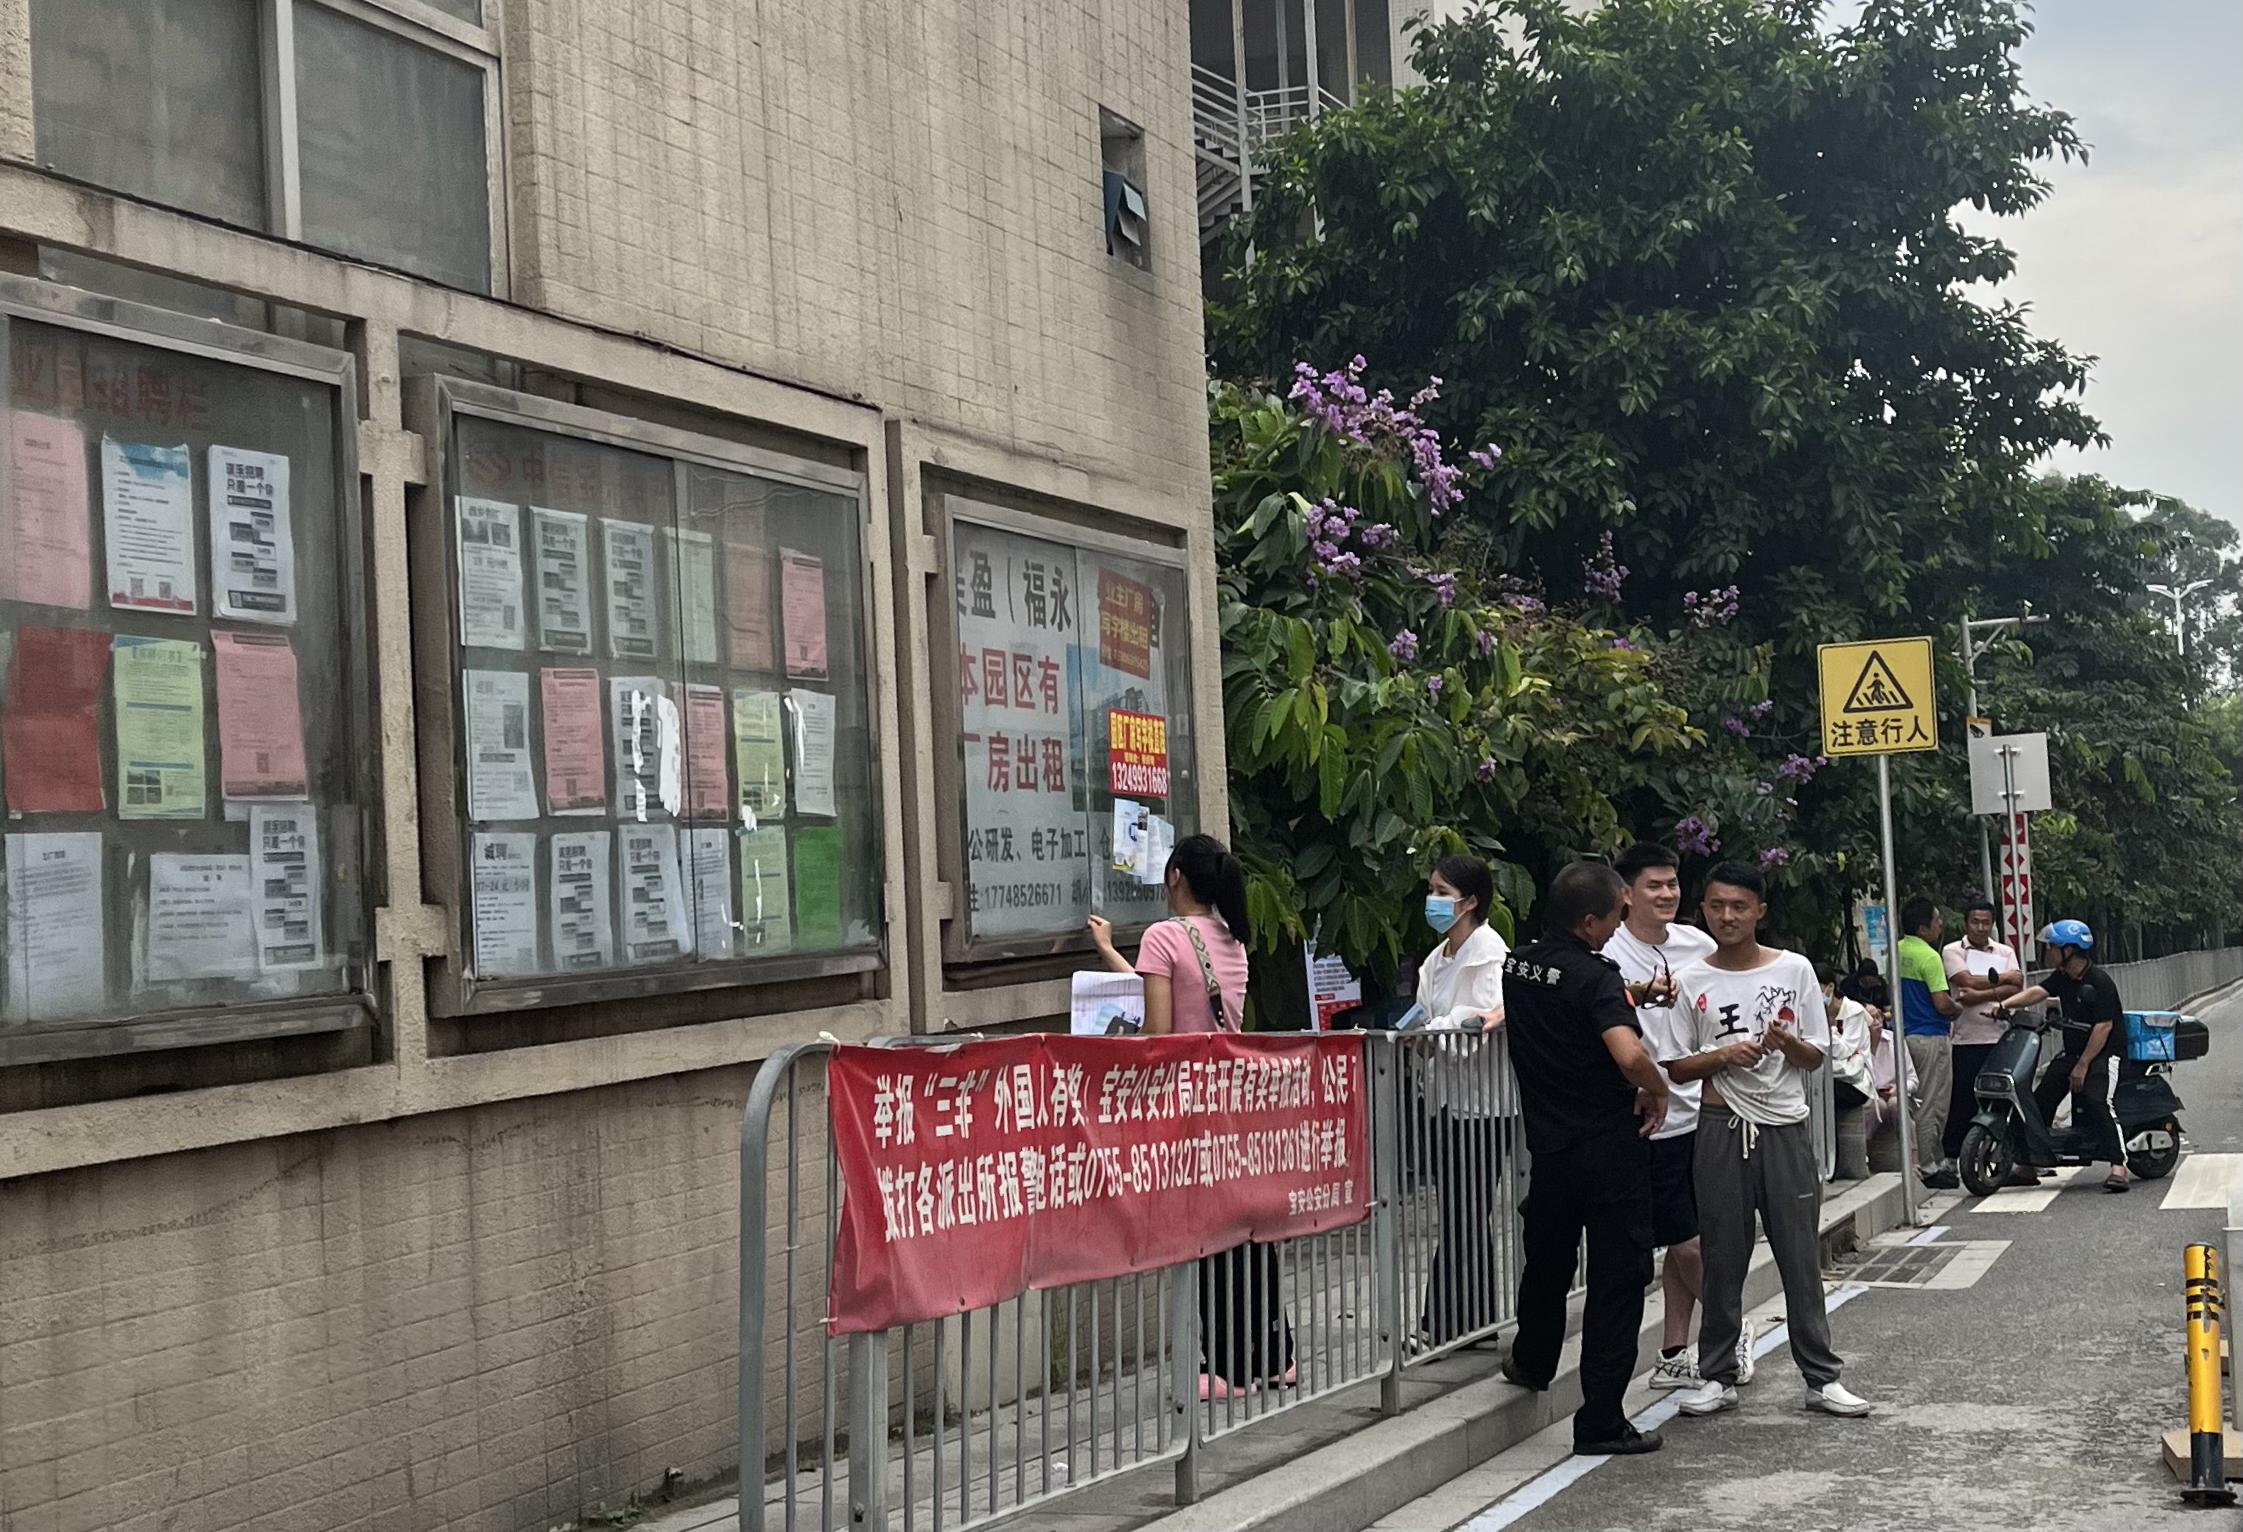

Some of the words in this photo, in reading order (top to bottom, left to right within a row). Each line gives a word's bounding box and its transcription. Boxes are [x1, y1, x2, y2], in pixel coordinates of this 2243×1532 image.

[961, 641, 1060, 715] 本园区有
[1830, 714, 1929, 748] 注意行人
[1112, 761, 1168, 795] 13249931668
[1504, 957, 1562, 986] 宝安义警
[1714, 1003, 1750, 1041] 王
